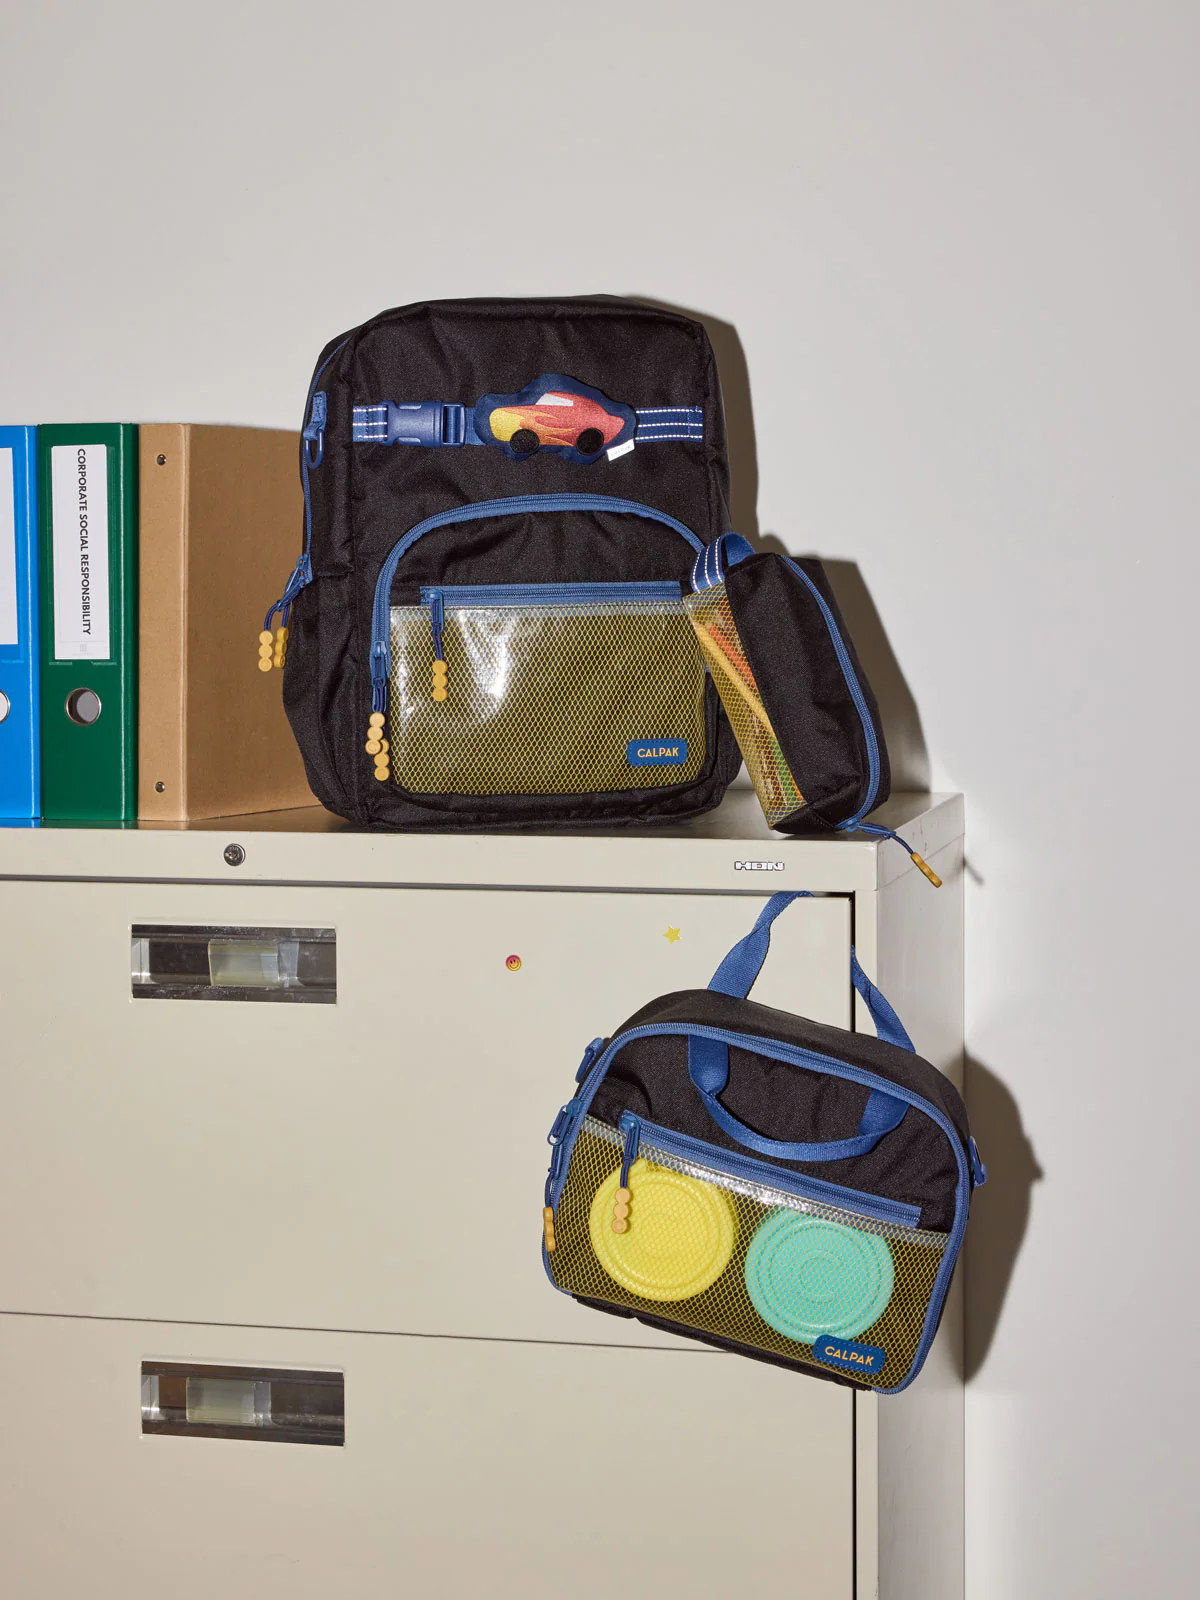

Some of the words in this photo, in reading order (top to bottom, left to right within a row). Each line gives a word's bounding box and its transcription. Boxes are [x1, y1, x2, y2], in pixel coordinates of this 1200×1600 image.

[77, 448, 88, 511] CORPORATE
[79, 514, 89, 551] SOCIAL
[80, 554, 91, 635] RESPONSIBILITY
[637, 747, 679, 758] CALPAK
[824, 1346, 874, 1366] CALPAK
